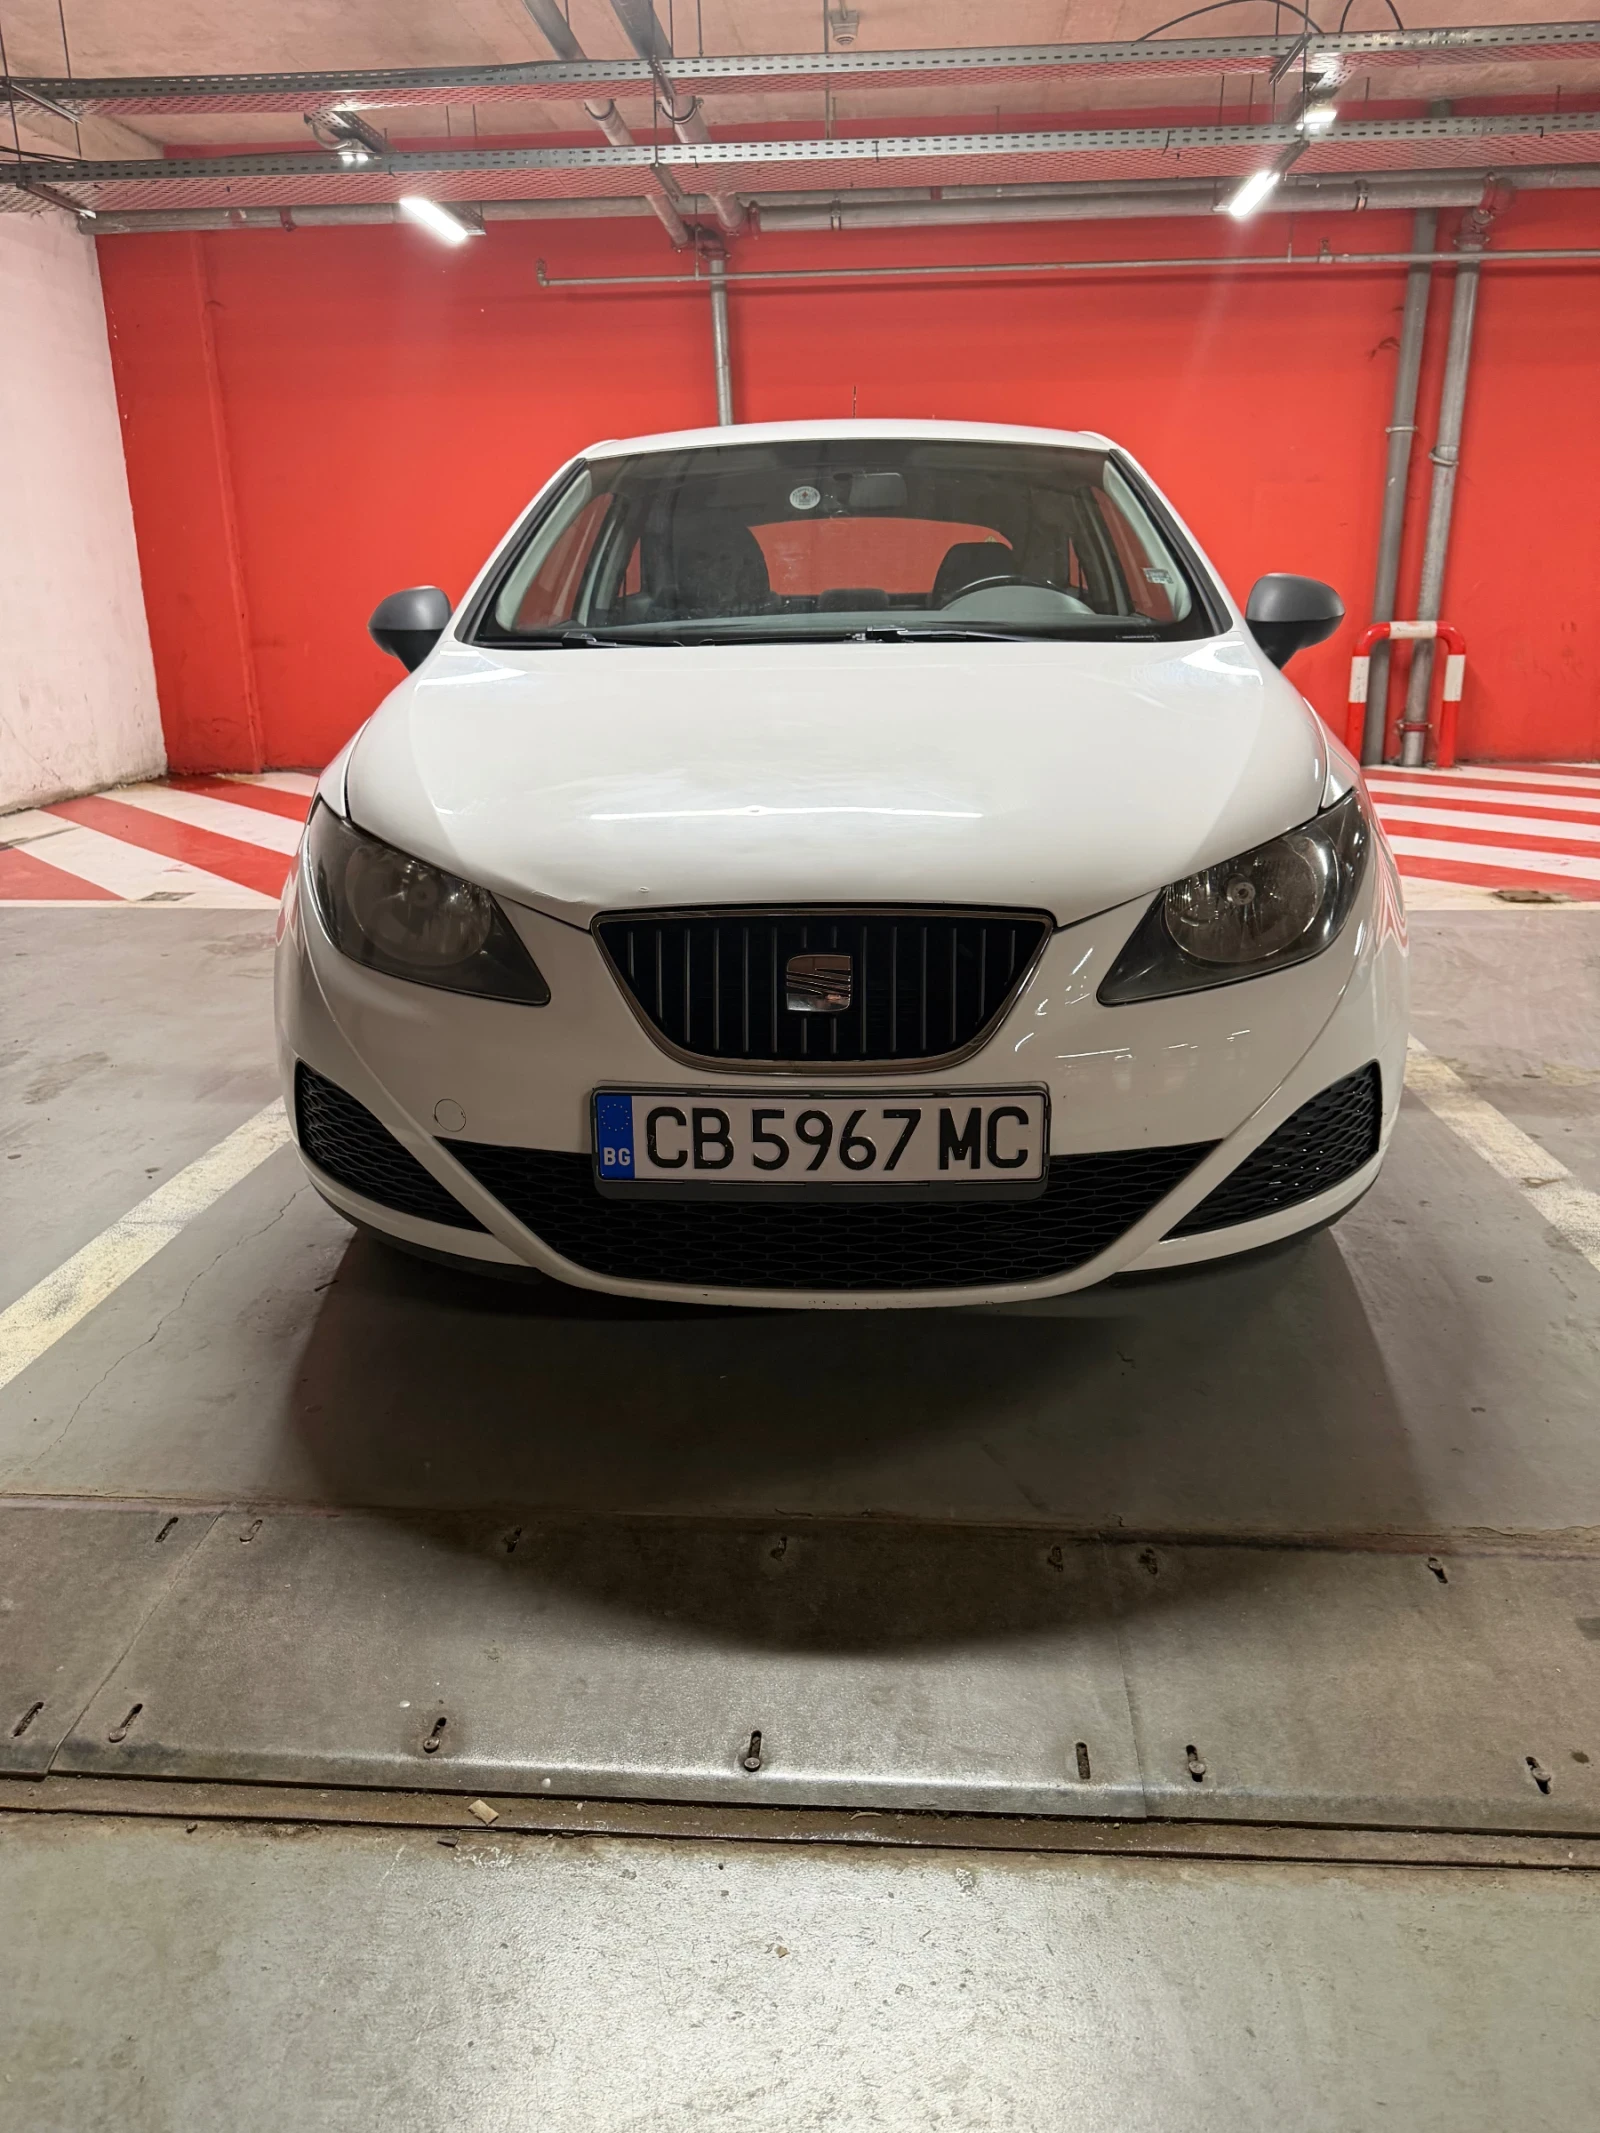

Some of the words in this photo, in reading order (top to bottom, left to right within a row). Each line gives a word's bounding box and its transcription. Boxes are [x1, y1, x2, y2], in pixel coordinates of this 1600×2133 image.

[603, 1146, 632, 1167] BG
[645, 1106, 734, 1170] CB
[751, 1108, 923, 1171] 5967
[938, 1106, 1030, 1170] MC
